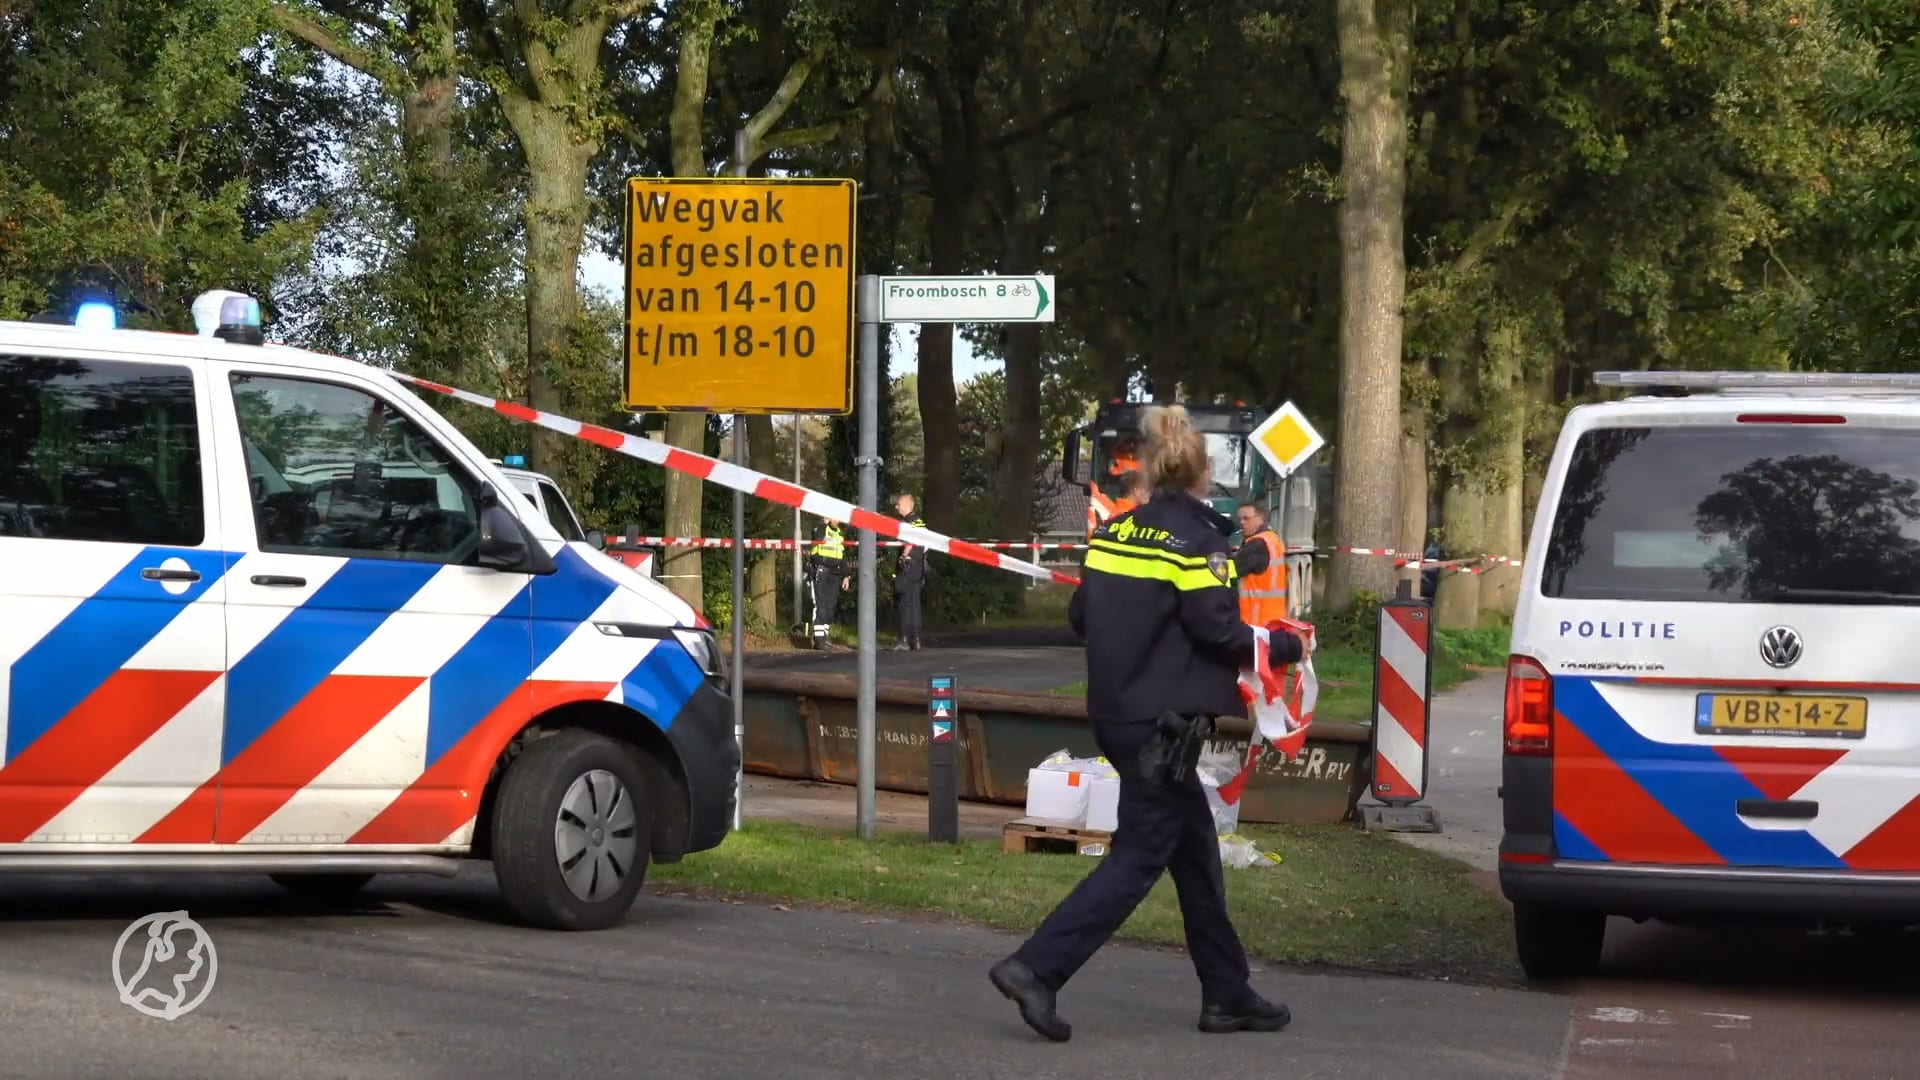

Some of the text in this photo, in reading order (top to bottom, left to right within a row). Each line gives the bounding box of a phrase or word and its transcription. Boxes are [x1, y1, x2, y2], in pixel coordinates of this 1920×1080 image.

[636, 191, 784, 232] Wegvak
[637, 235, 843, 276] afgesloten
[636, 280, 816, 313] van 14-10
[890, 284, 1007, 298] Froombosch 8
[636, 324, 815, 366] t/m 18-10
[1560, 621, 1676, 639] POLITIE
[1725, 699, 1850, 726] VBR-14-Z
